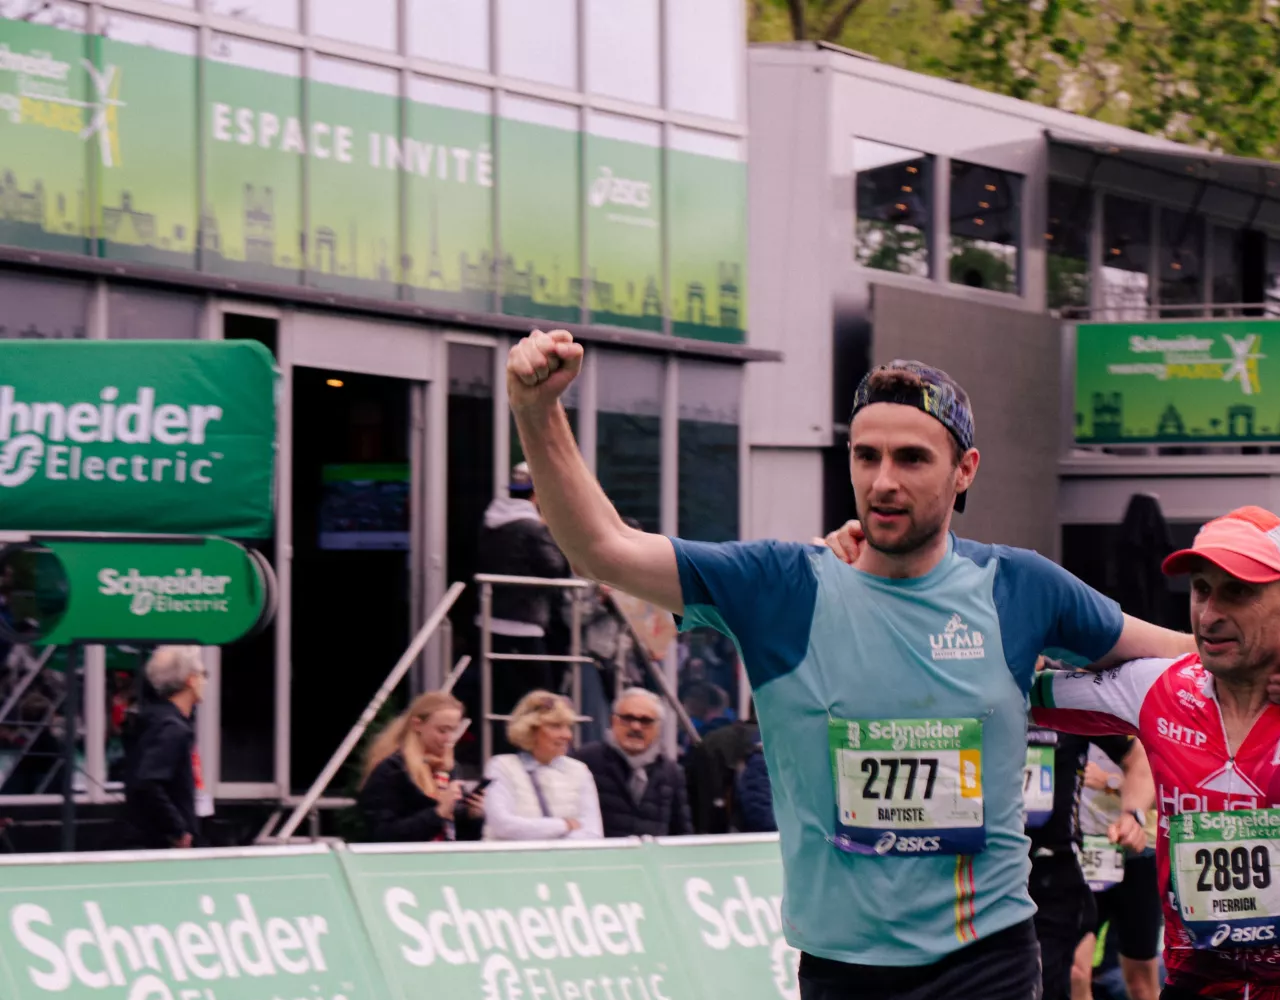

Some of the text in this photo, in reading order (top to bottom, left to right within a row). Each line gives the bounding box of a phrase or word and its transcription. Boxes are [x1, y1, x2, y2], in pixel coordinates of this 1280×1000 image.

[213, 102, 494, 187] ESPACE INVITÉ
[0, 384, 223, 444] hneider
[46, 444, 213, 484] Electric
[98, 568, 231, 596] Schneider
[155, 597, 229, 612] Electric
[929, 631, 984, 649] UTMB
[868, 721, 964, 740] Schneider
[1157, 717, 1207, 746] SHTP
[861, 758, 939, 800] 2777
[878, 807, 925, 822] BAPTISTE
[896, 836, 942, 852] asics
[1195, 845, 1272, 892] 2899
[1212, 897, 1257, 913] PIERRICK
[384, 881, 647, 966] Schneider
[1230, 924, 1275, 942] asics
[10, 893, 329, 992] Schneider
